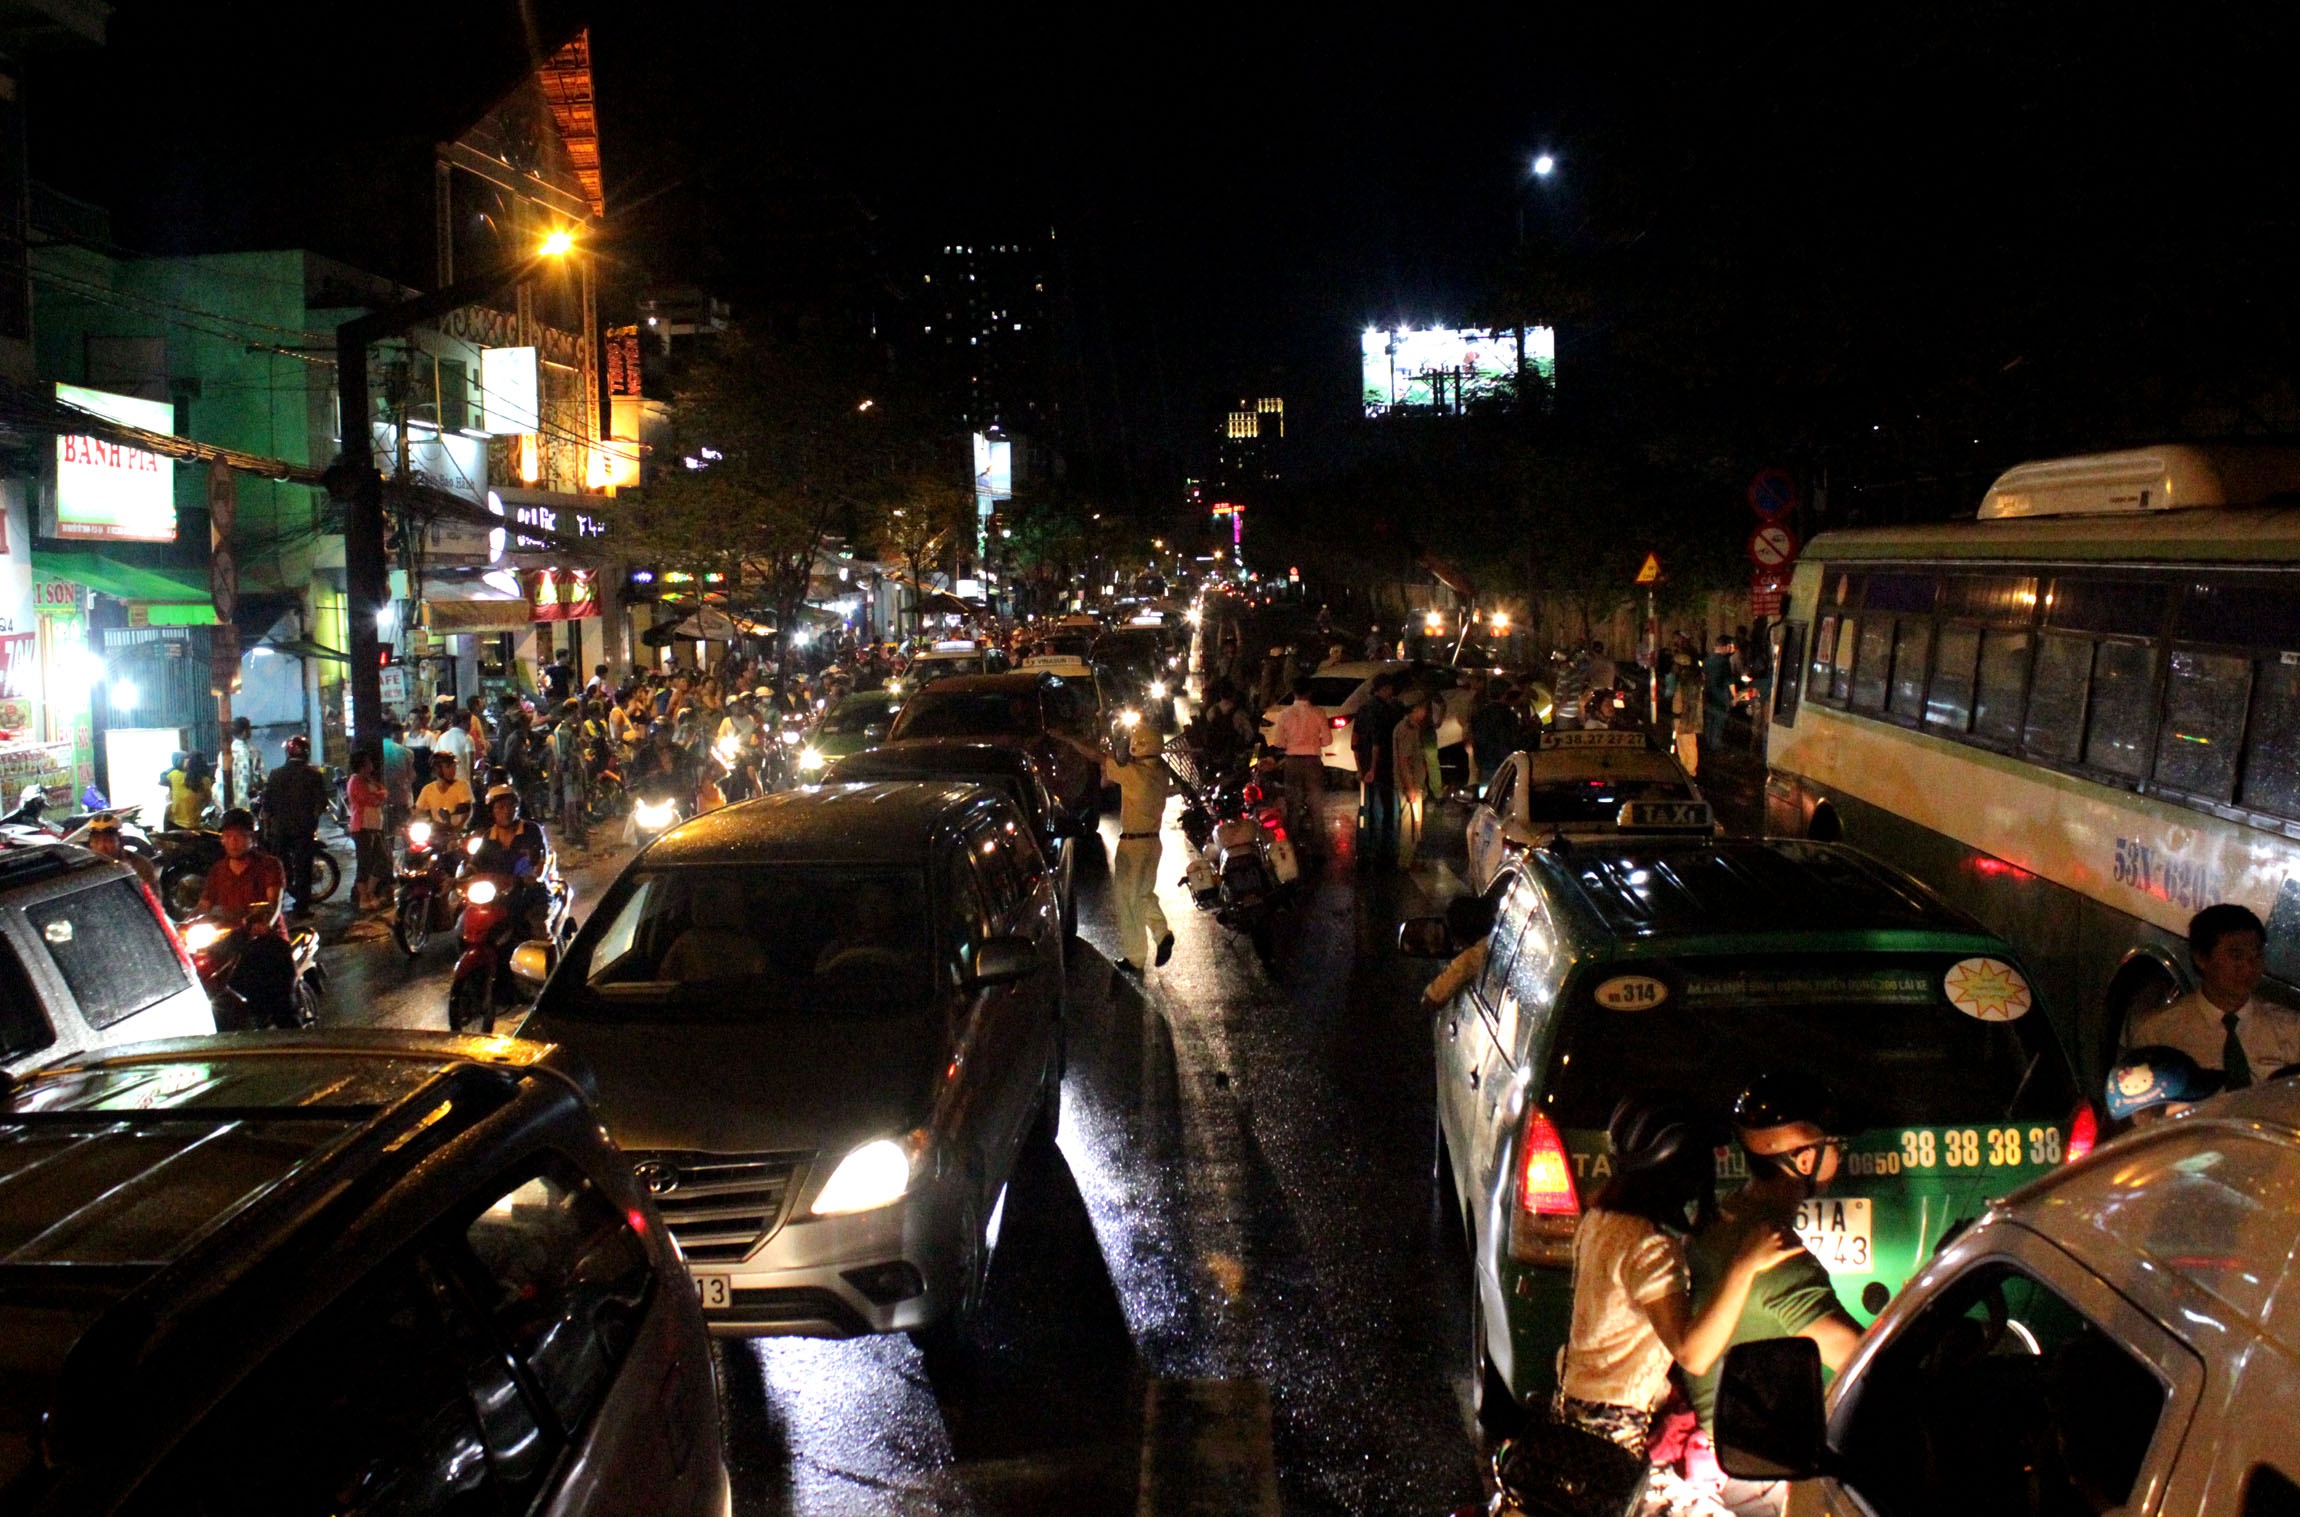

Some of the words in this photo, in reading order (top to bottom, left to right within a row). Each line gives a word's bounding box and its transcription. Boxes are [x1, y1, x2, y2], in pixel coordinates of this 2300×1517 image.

[1643, 804, 1696, 824] TAXI
[1624, 983, 1656, 1002] 314
[1848, 1151, 1900, 1175] 0650
[1901, 1130, 1936, 1168] 38
[1944, 1129, 1980, 1168] 38
[1987, 1128, 2022, 1167] 38
[2028, 1126, 2062, 1165] 38
[1795, 1201, 1846, 1232] 61A
